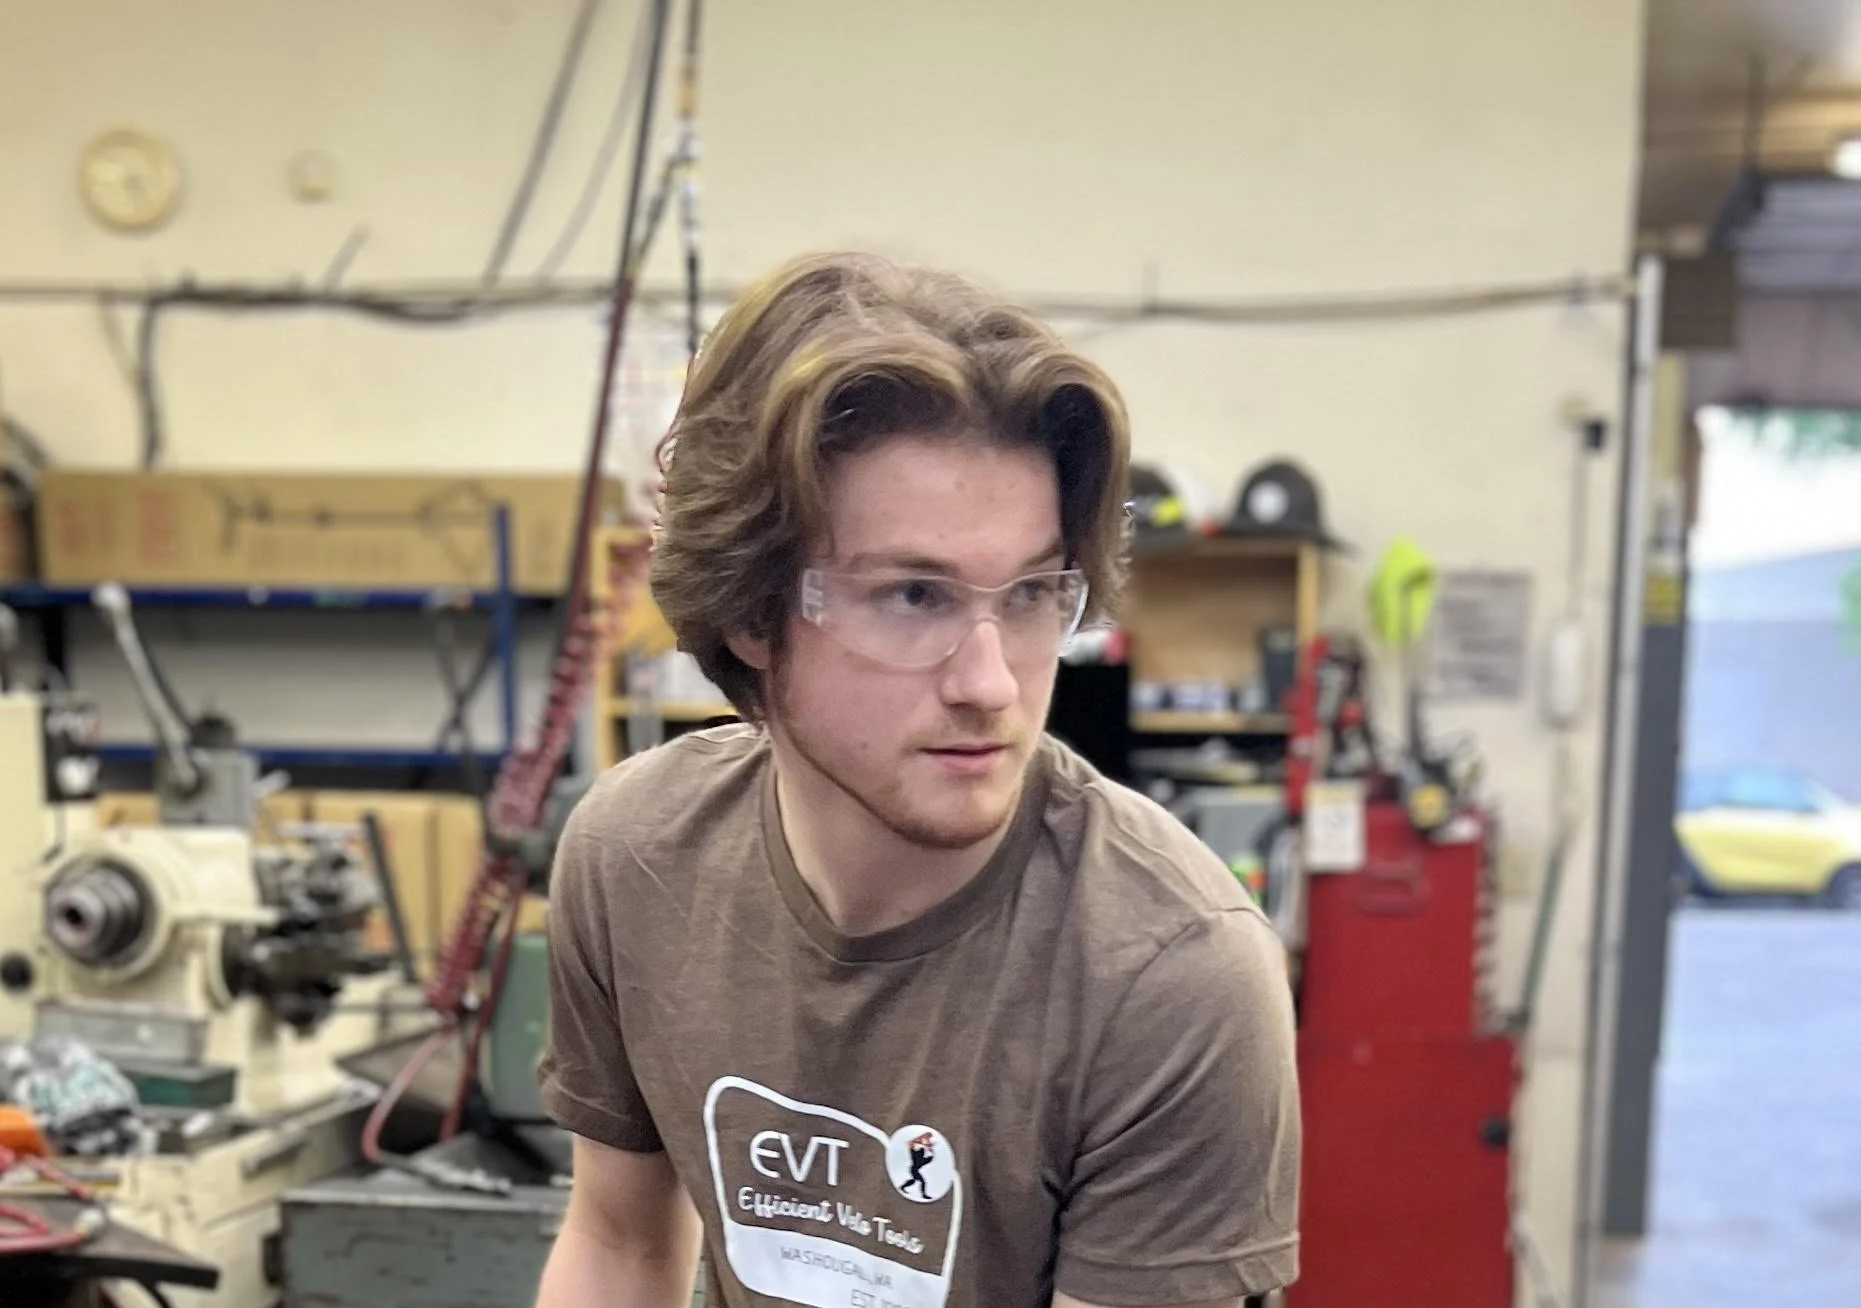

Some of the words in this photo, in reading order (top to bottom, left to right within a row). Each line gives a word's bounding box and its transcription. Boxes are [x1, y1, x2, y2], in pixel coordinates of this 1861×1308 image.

[750, 1130, 849, 1187] EVT
[738, 1186, 834, 1223] Efficient
[872, 1216, 924, 1254] Tools
